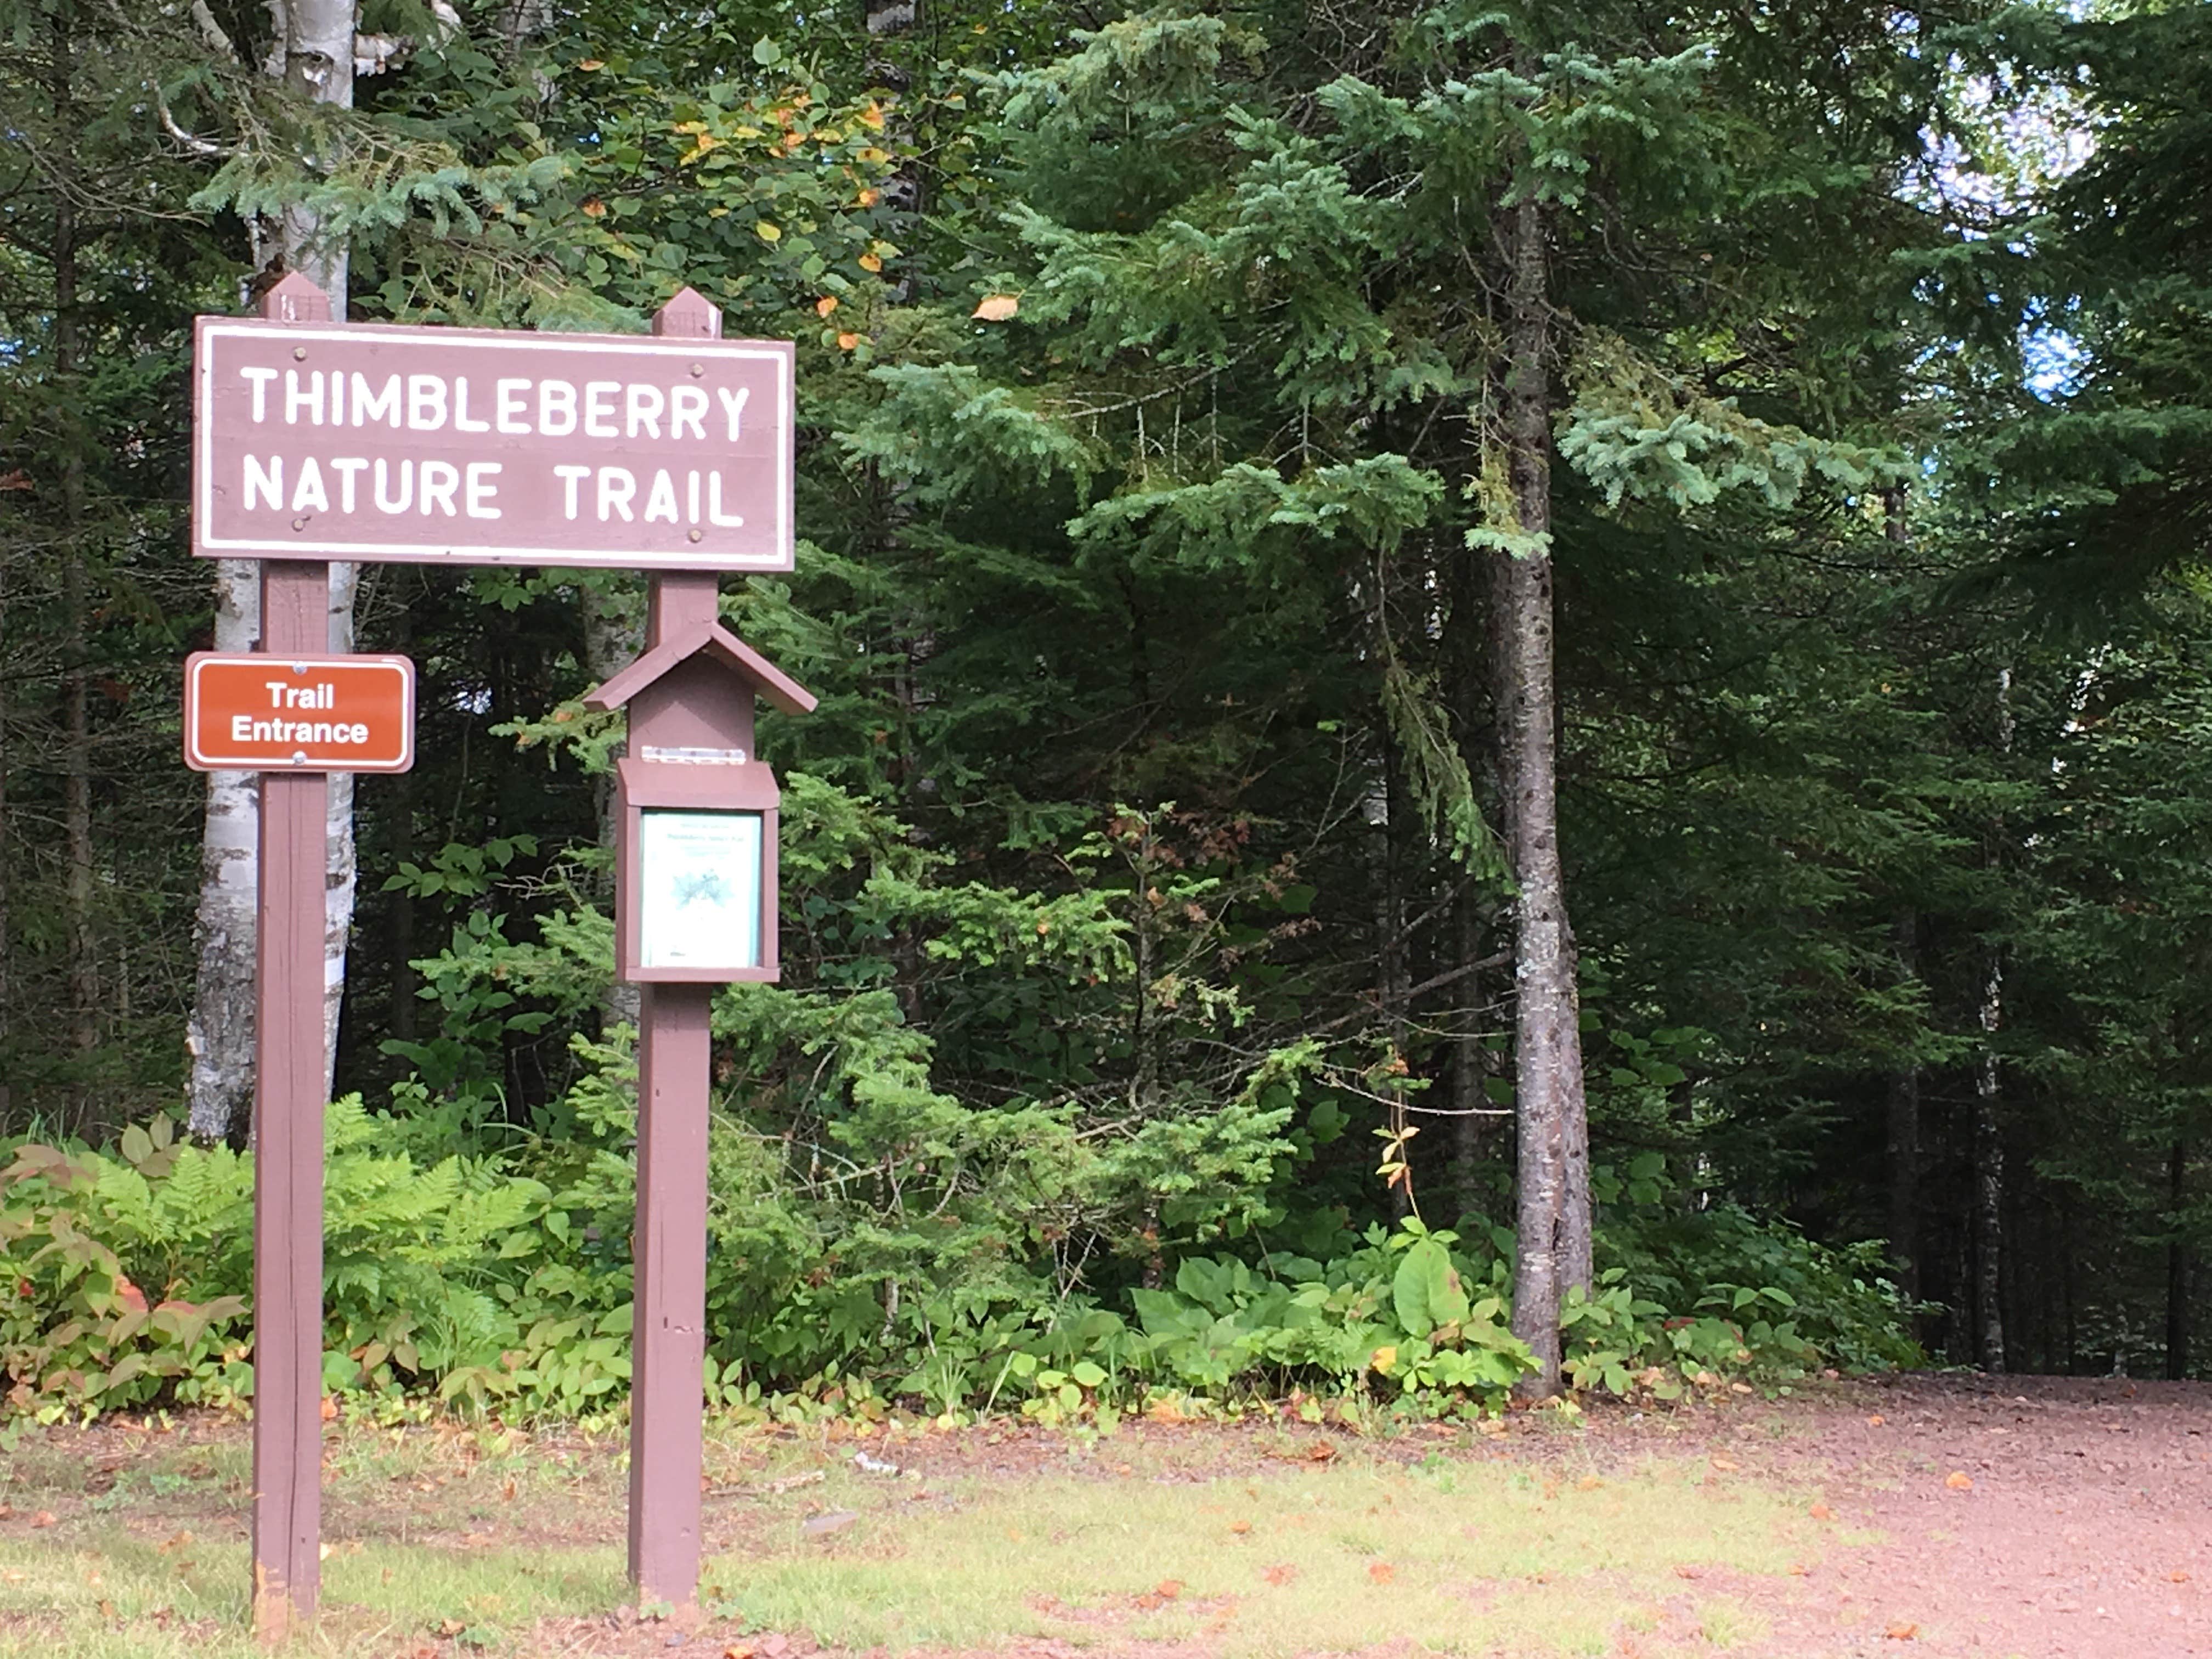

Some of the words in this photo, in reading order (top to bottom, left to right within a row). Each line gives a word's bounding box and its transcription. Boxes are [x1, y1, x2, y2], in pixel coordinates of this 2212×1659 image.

[240, 366, 750, 442] THIMBLEBERRY
[243, 454, 503, 520] NATURE
[553, 465, 744, 528] TRAIL
[266, 682, 334, 709] Trail
[232, 715, 369, 744] Entrance
